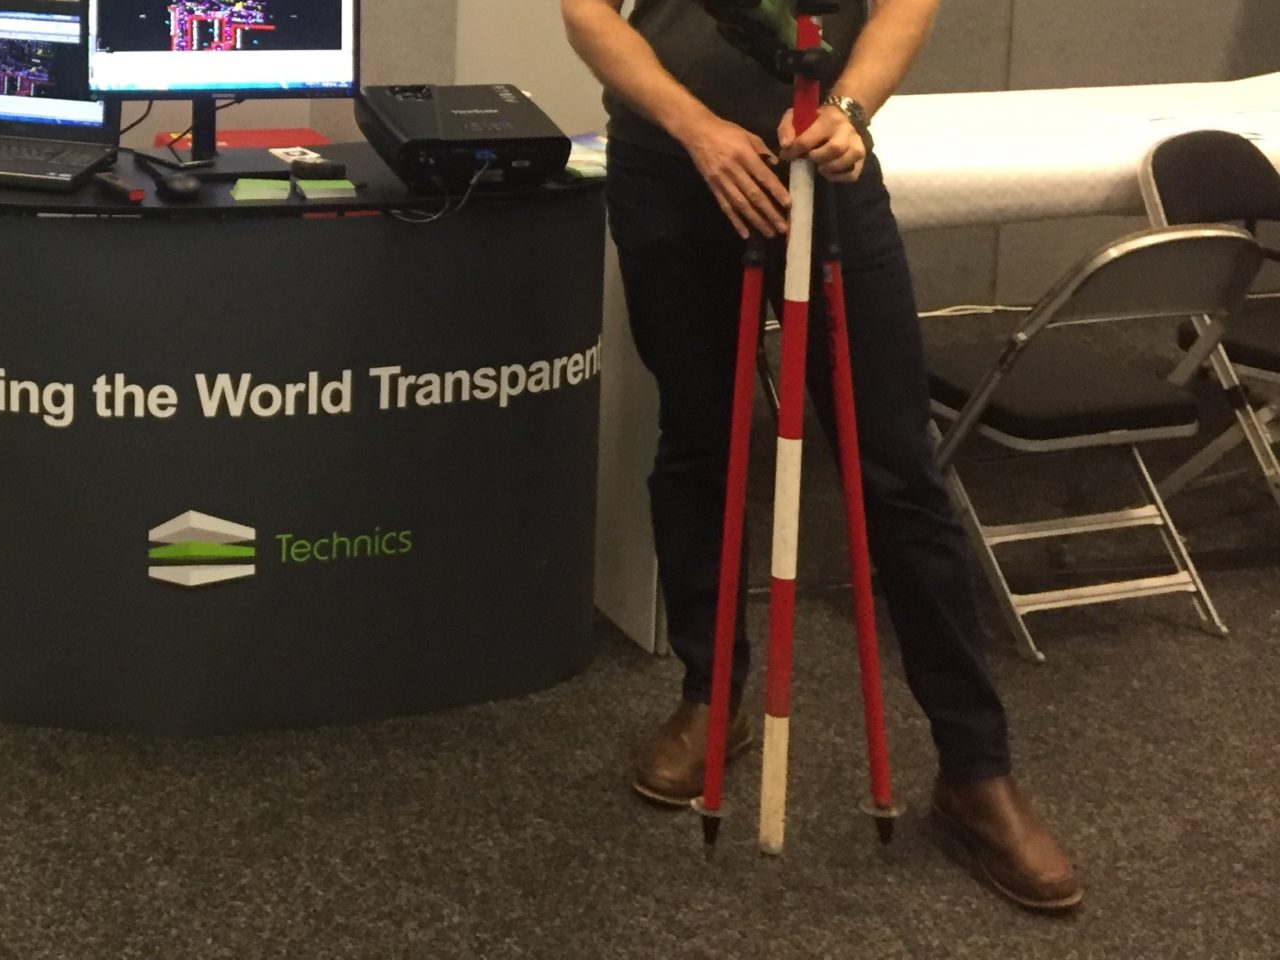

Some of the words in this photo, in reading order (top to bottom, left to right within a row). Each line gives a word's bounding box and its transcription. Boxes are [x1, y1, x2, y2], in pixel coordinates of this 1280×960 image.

[92, 373, 178, 418] the
[196, 370, 352, 418] World
[276, 526, 413, 564] Technics
